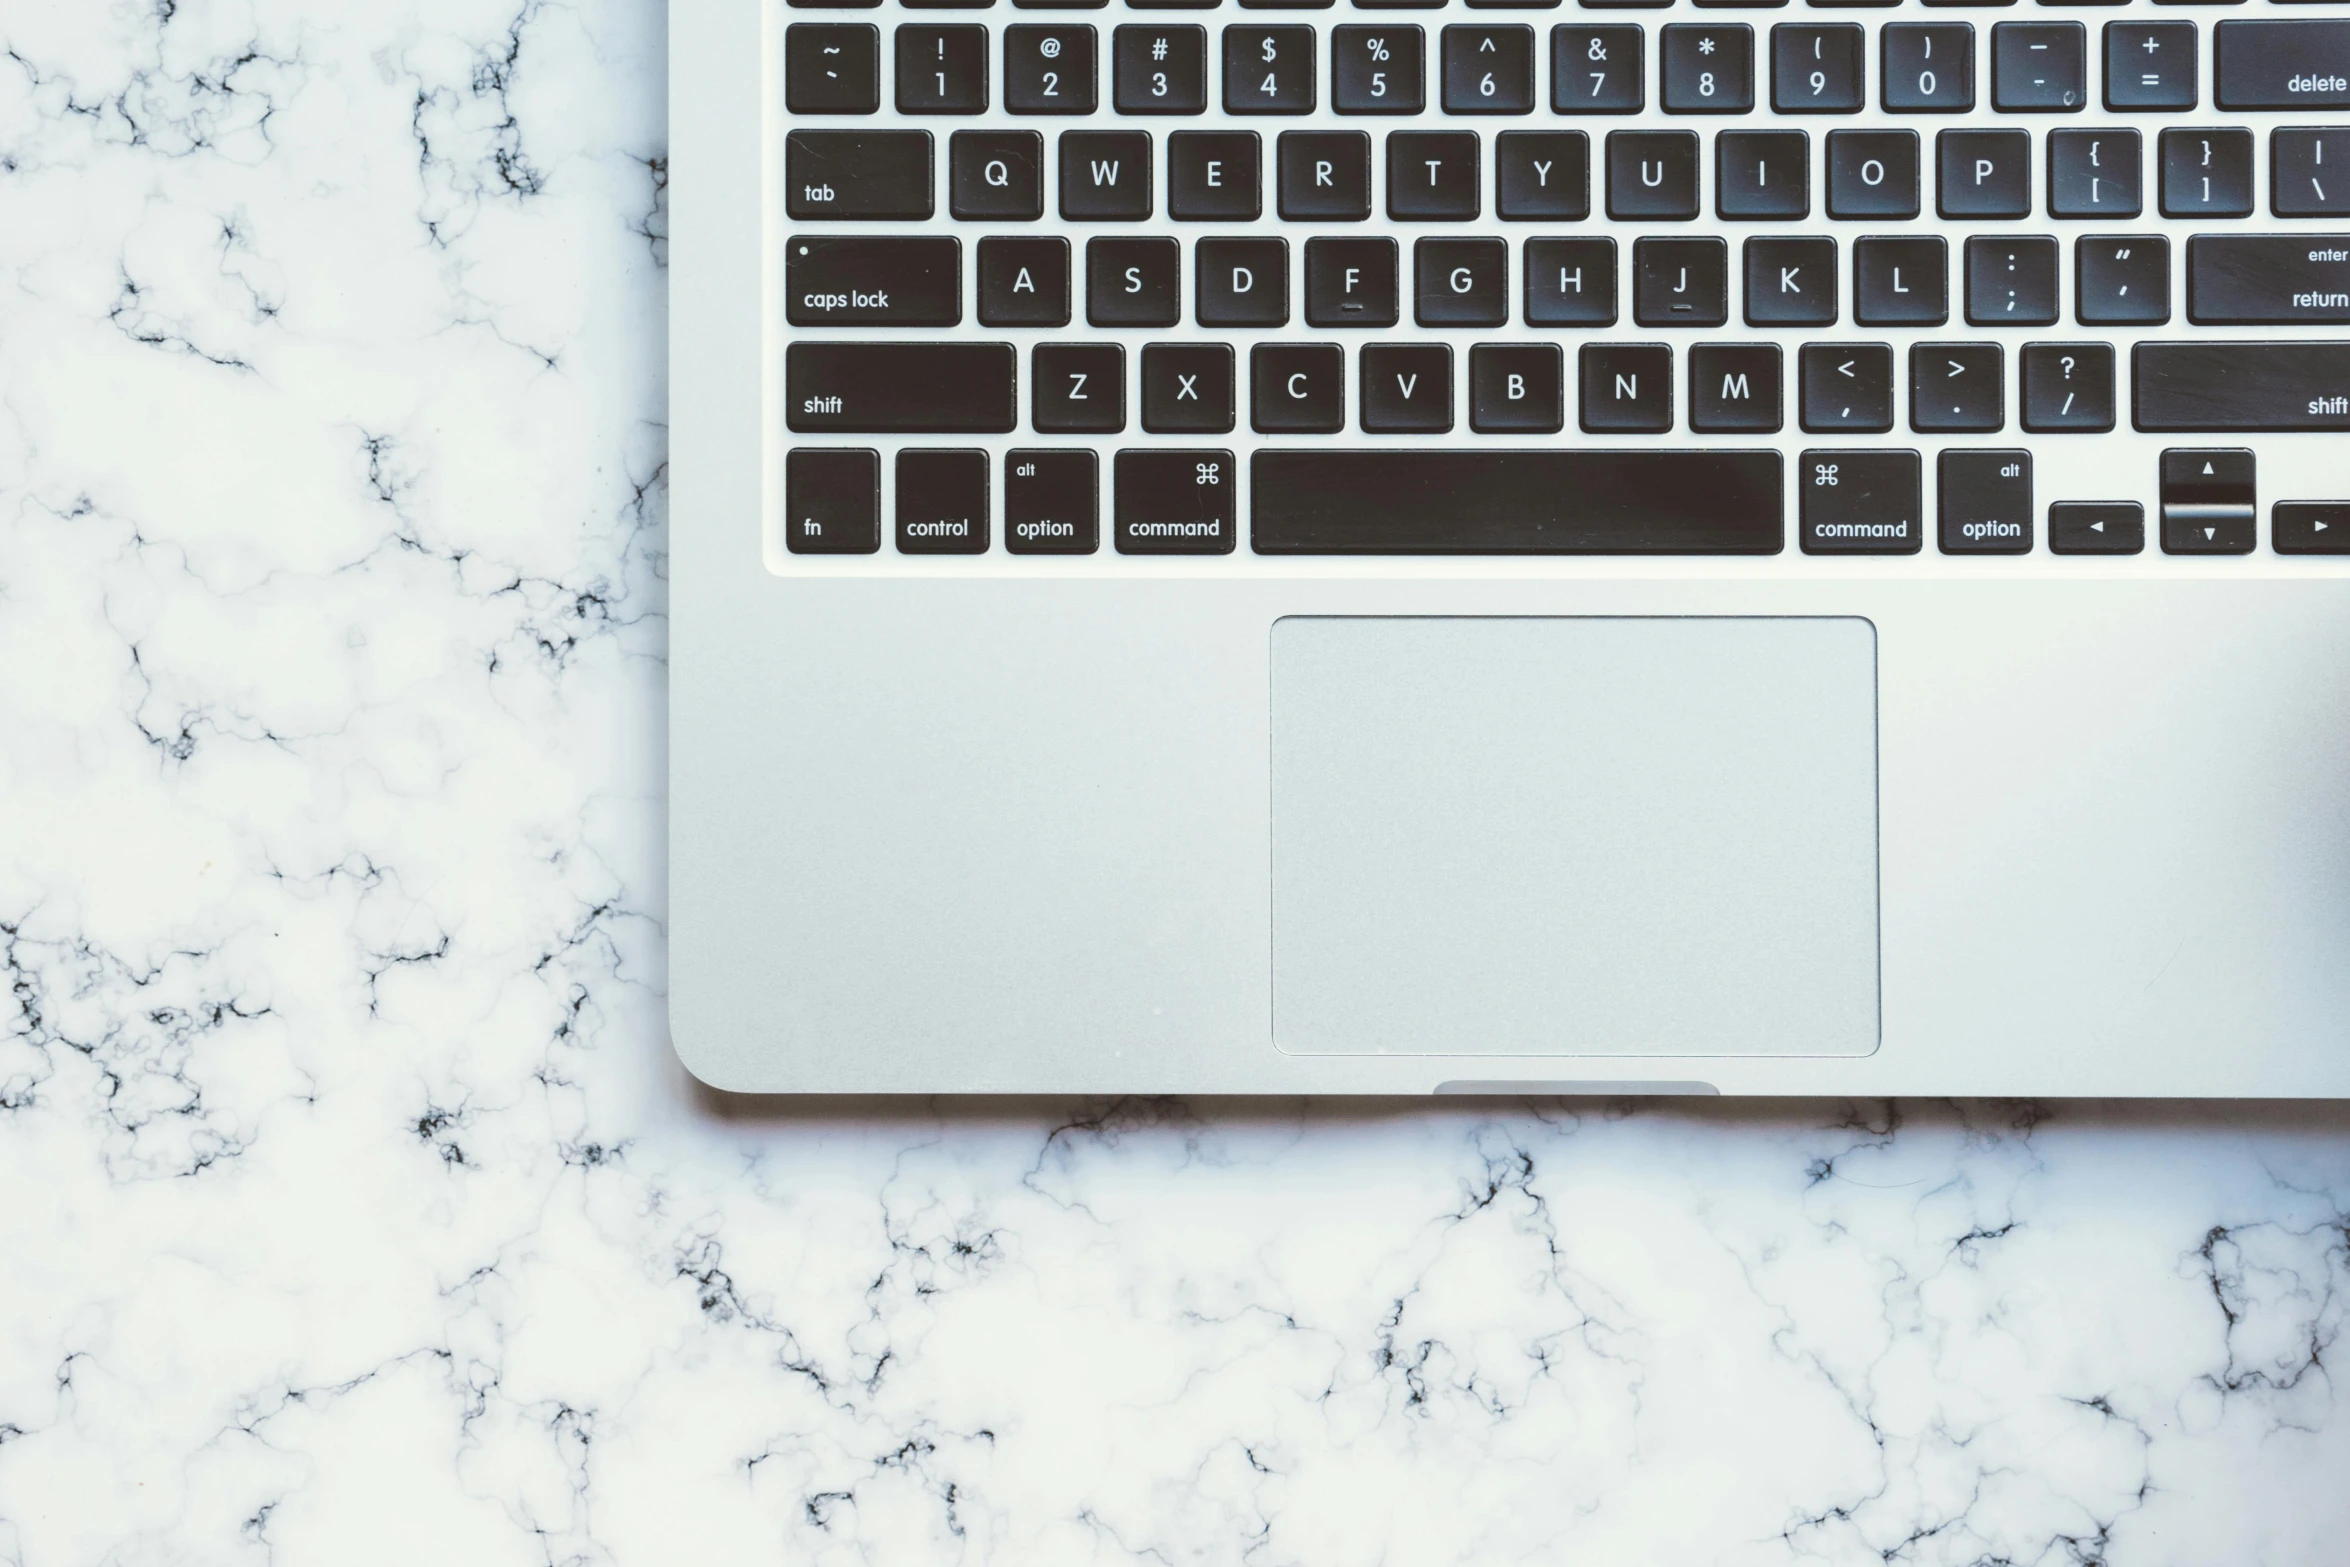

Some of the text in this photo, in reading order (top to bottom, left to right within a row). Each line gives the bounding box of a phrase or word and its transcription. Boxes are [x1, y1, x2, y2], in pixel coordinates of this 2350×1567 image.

[1039, 37, 1061, 58] @
[1151, 38, 1169, 61] #
[1261, 36, 1277, 63] $
[1366, 38, 1390, 62] %
[1587, 37, 1607, 61] &
[1813, 36, 1822, 60] (
[1923, 36, 1932, 59] )
[2142, 36, 2160, 54] +
[935, 72, 945, 97] 1
[1042, 72, 1059, 96] 2
[1151, 72, 1168, 97] 3
[1260, 72, 1278, 97] 4
[1370, 72, 1386, 97] 5
[1479, 72, 1496, 97] 6
[1589, 72, 1606, 97] 7
[1699, 72, 1715, 97] 8
[1809, 71, 1826, 96] 9
[2141, 73, 2160, 86] =
[2287, 73, 2348, 93] delete
[2089, 141, 2100, 167] {
[2201, 140, 2212, 166] }
[984, 160, 1009, 187] Q
[1090, 160, 1119, 186] W
[1207, 161, 1222, 187] E
[1316, 160, 1333, 187] R
[1425, 160, 1442, 187] T
[1533, 160, 1552, 187] Y
[1641, 160, 1663, 187] U
[1861, 159, 1885, 186] O
[1975, 159, 1994, 186] P
[804, 183, 835, 202] tab
[2091, 177, 2101, 203] [
[2201, 176, 2211, 203] ]
[2308, 248, 2350, 262] enter
[1013, 267, 1035, 293] A
[1125, 267, 1142, 293] S
[1232, 267, 1253, 293] D
[1345, 268, 1360, 294] F
[1449, 267, 1473, 294] G
[1560, 267, 1581, 293] H
[1673, 267, 1686, 293] J
[1781, 267, 1801, 293] K
[1893, 266, 1909, 293] L
[804, 289, 889, 312] caps lock
[2293, 290, 2350, 308] return
[1837, 360, 1855, 378] <
[1948, 360, 1965, 378] >
[2060, 356, 2075, 380] ?
[1068, 373, 1088, 400] Z
[1176, 374, 1198, 401] X
[1287, 373, 1308, 399] C
[1396, 373, 1417, 399] V
[1508, 374, 1526, 400] B
[1615, 373, 1637, 400] N
[1721, 373, 1750, 399] M
[803, 395, 843, 414] shift
[2061, 392, 2075, 416] /
[2307, 396, 2350, 415] shift
[1016, 462, 1036, 477] alt
[2000, 463, 2020, 477] alt
[803, 517, 822, 536] fn
[906, 518, 968, 537] control
[1016, 520, 1074, 541] option
[1129, 518, 1220, 536] command
[1815, 519, 1908, 538] command
[1962, 519, 2021, 541] option
